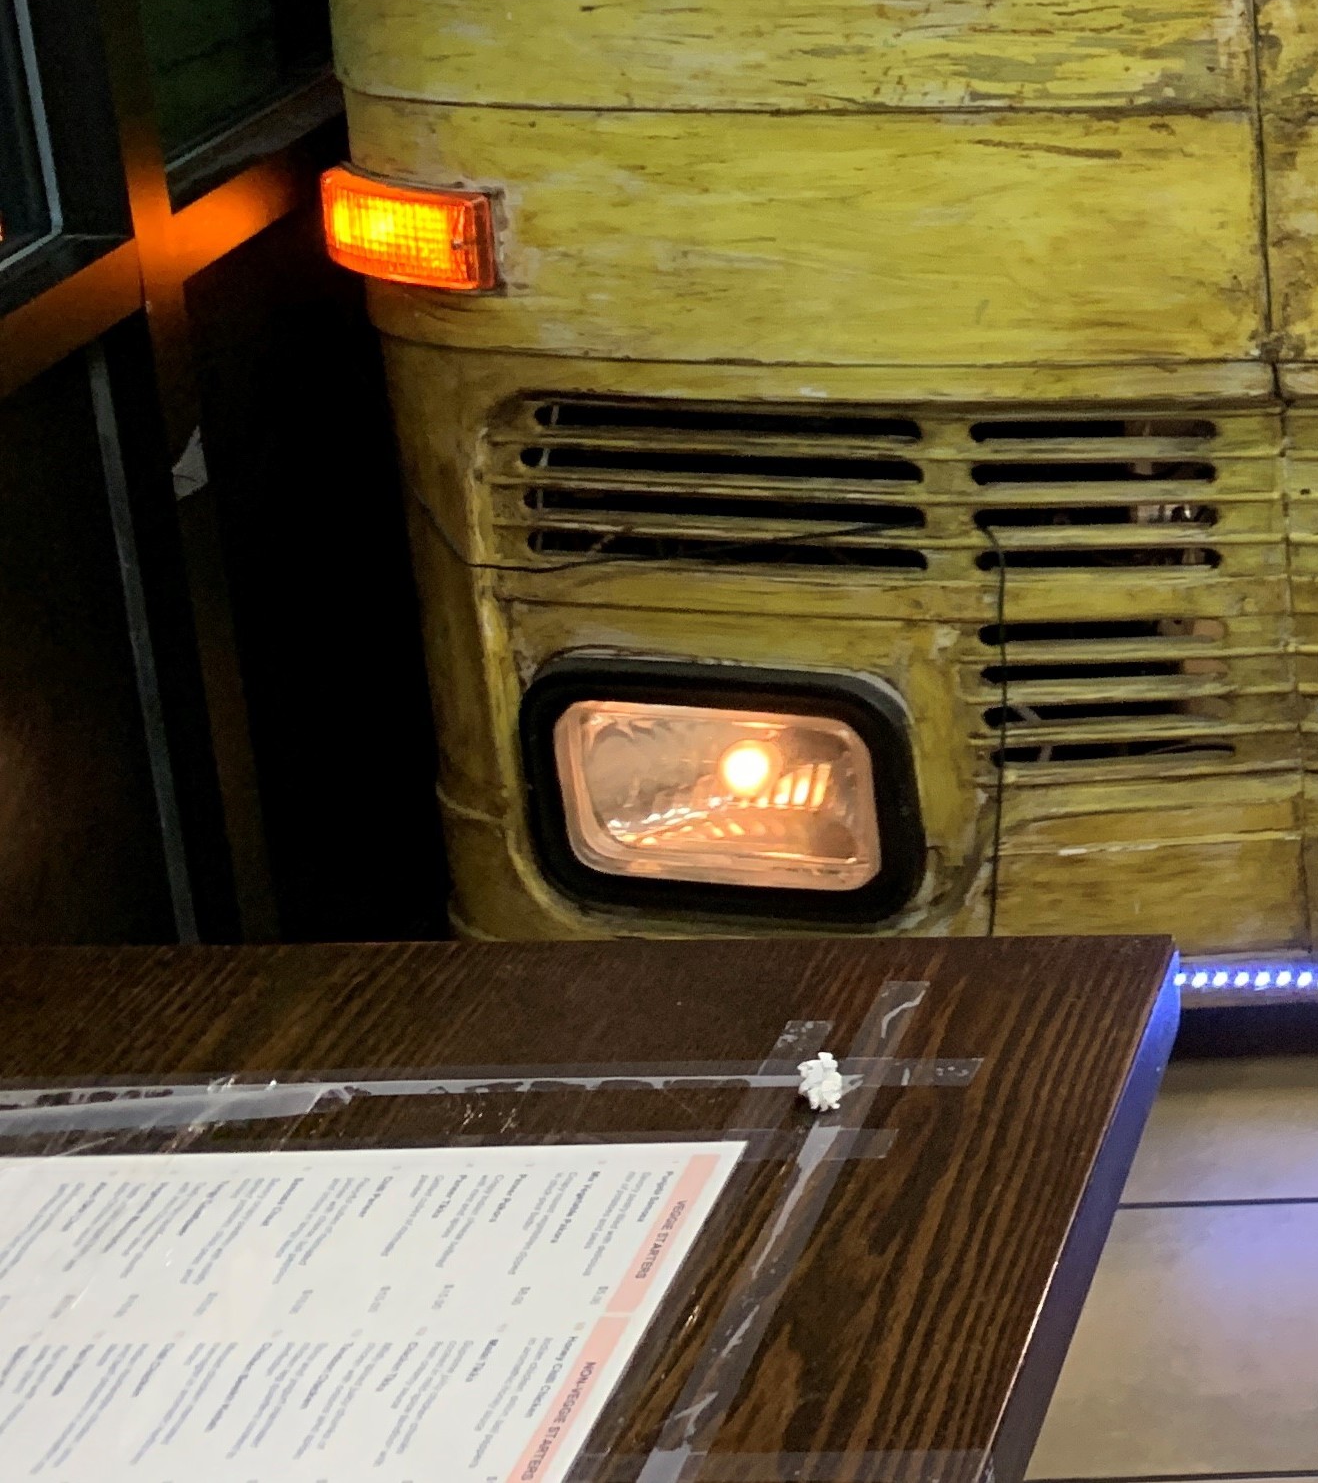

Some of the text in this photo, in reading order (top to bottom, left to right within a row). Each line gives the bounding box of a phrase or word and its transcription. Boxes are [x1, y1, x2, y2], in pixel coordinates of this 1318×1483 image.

[632, 1199, 689, 1279] VEGGIE STARTERS
[518, 1361, 598, 1481] NON-VEGGIE STARTERS
